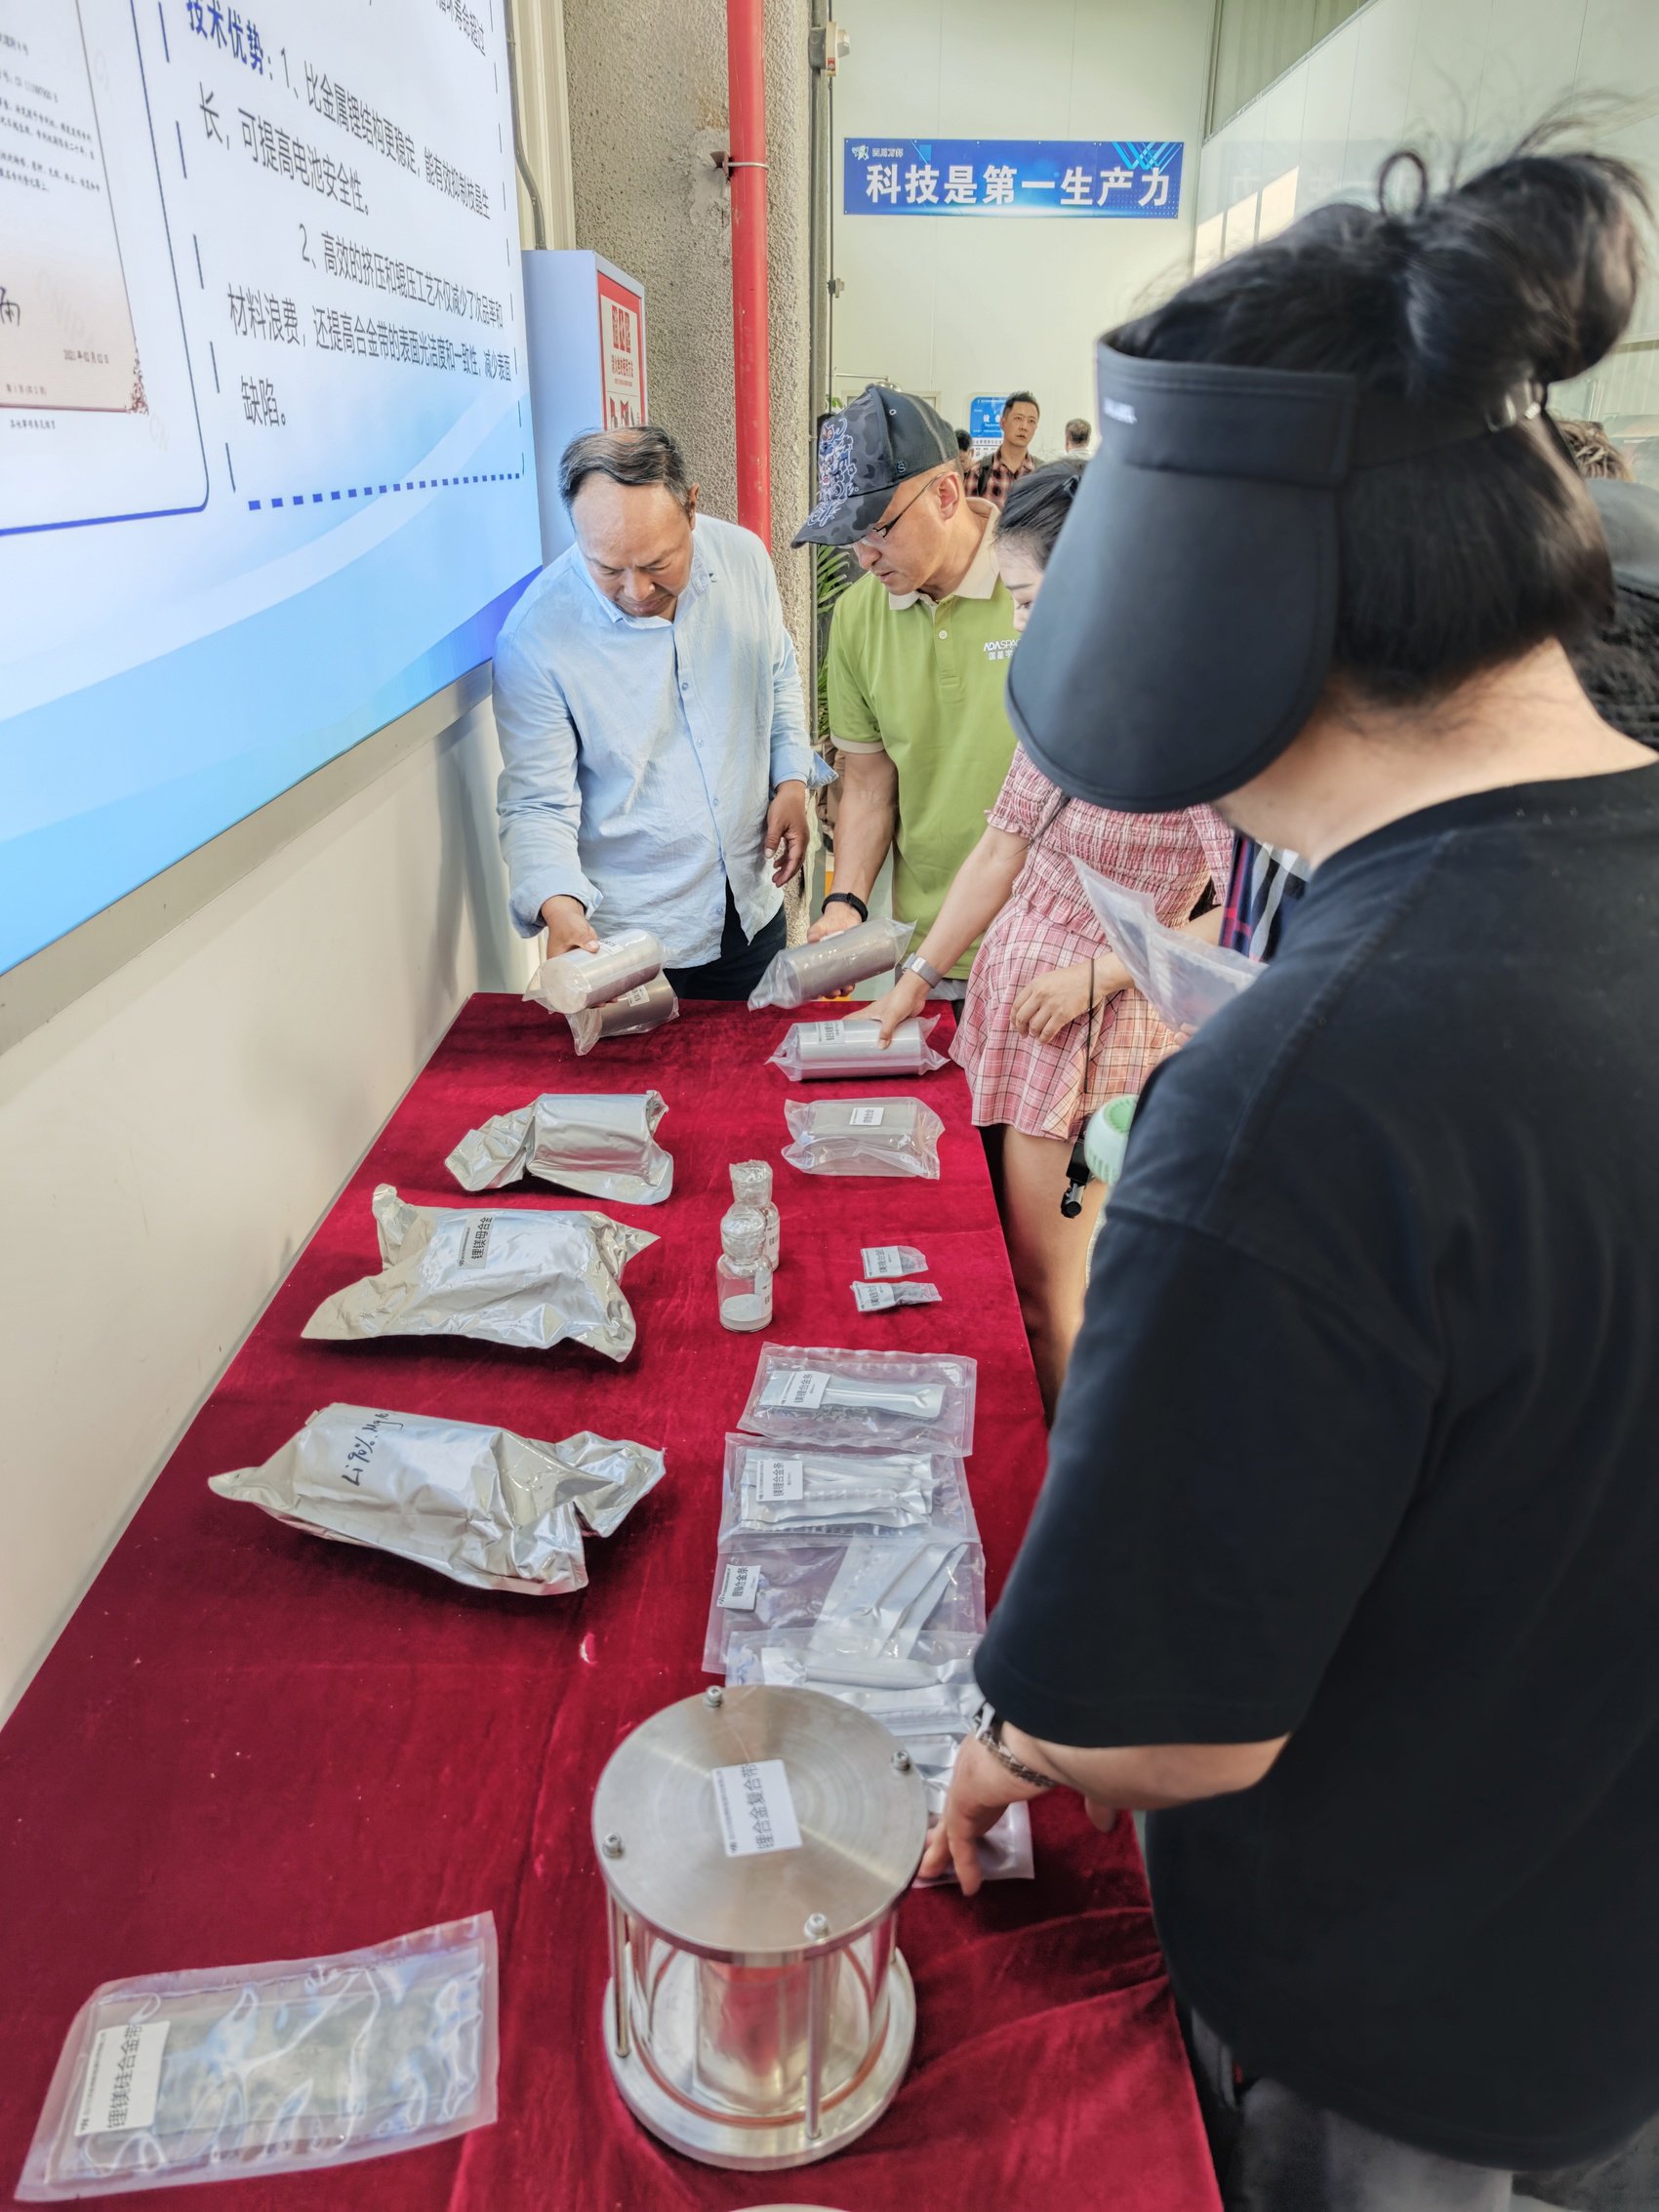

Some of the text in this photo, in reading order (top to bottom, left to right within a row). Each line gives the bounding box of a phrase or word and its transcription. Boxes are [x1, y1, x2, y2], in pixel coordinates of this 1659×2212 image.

[866, 164, 1170, 208] 科技是第一生产力
[470, 1217, 493, 1260] 锂镁母合金
